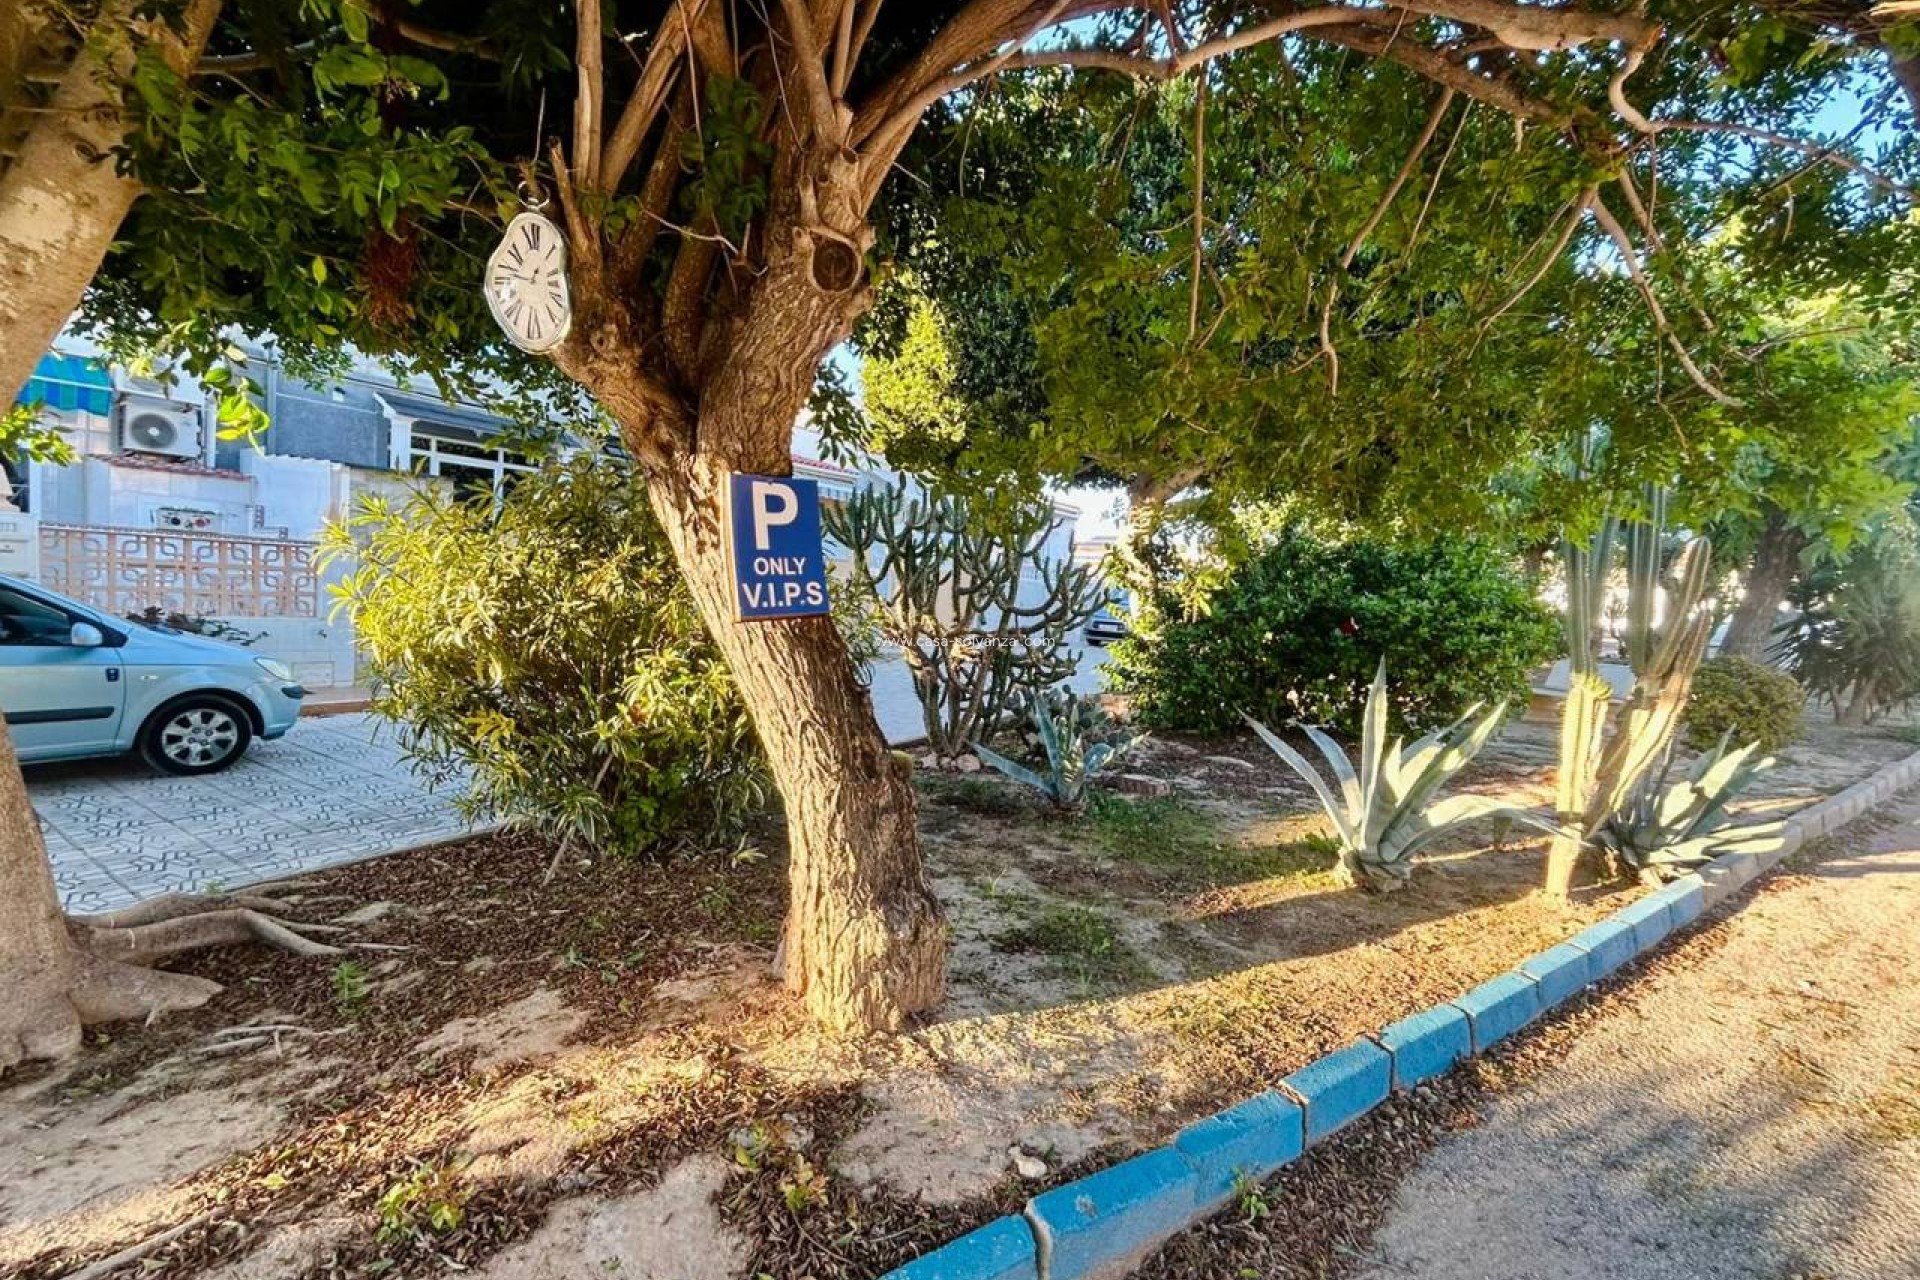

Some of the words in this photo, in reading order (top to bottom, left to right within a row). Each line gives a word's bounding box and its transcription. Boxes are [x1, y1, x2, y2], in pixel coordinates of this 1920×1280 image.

[752, 481, 799, 550] P
[753, 557, 806, 575] ONLY
[742, 581, 823, 608] V.I.P.S
